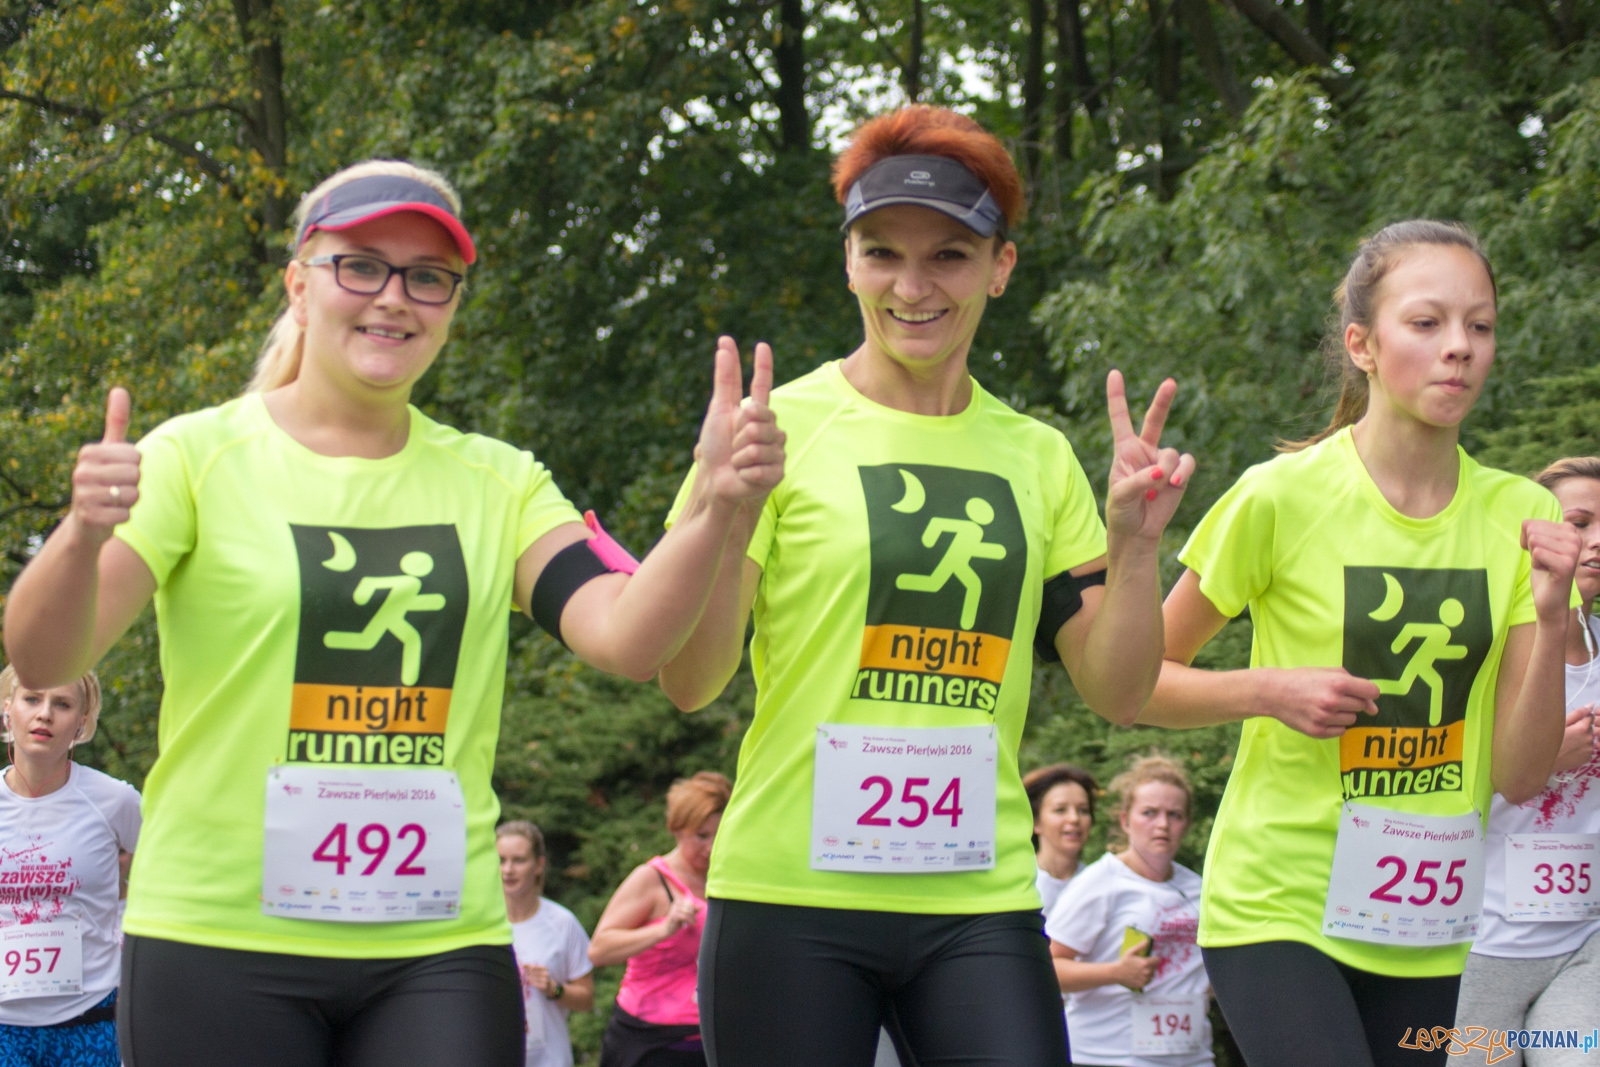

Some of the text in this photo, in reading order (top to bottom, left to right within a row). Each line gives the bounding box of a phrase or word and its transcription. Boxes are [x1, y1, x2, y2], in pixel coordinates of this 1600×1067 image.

[890, 627, 982, 671] night
[852, 670, 998, 711] runners
[327, 687, 428, 730] night
[288, 731, 444, 764] runners
[862, 742, 903, 754] Zawsze
[907, 744, 948, 757] Pier(w)si
[950, 745, 972, 755] 2016
[1363, 728, 1448, 767] night
[318, 787, 436, 801] Zawsze Pier(w)si 2016
[856, 775, 963, 828] 254
[1382, 824, 1475, 842] Zawsze Pier(w)si 2016
[312, 823, 427, 876] 492
[0, 882, 75, 900] ier(w)si!
[1, 871, 66, 884] zawsze
[1369, 855, 1467, 906] 255
[1533, 863, 1591, 894] 335
[4, 947, 61, 976] 957
[1152, 1014, 1192, 1036] 194
